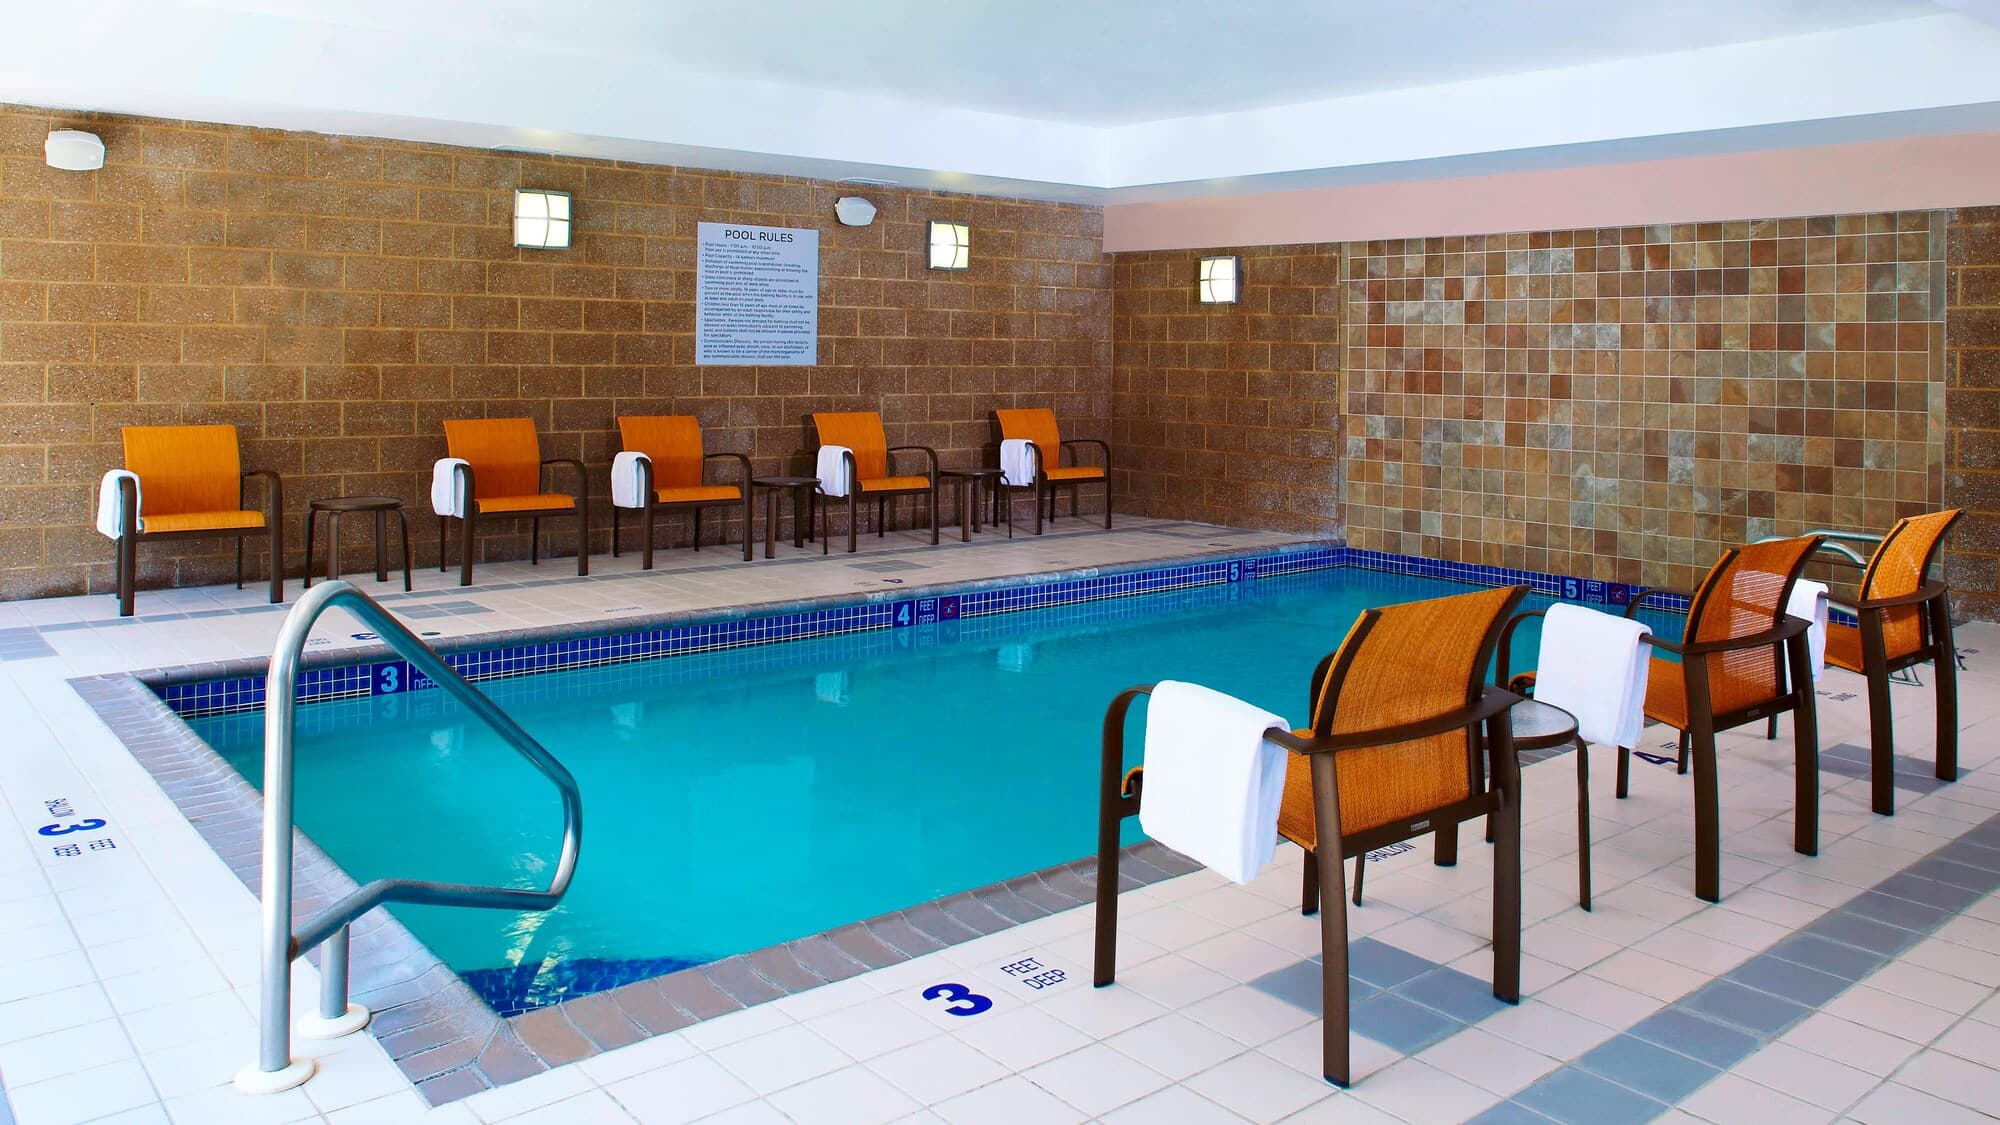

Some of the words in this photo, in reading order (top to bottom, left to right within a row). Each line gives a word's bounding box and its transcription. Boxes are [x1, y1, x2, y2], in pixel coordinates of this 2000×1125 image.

[725, 230, 755, 240] POOL
[760, 232, 793, 242] RULES
[1230, 563, 1239, 581] 5
[1565, 579, 1577, 598] 5
[1586, 581, 1602, 592] FEET
[897, 604, 910, 626] 4
[919, 600, 935, 612] FEET
[380, 666, 398, 693] 3
[38, 818, 107, 836] 3
[1000, 957, 1045, 976] FEET
[1022, 969, 1067, 989] DEEP
[922, 983, 993, 1016] 3
